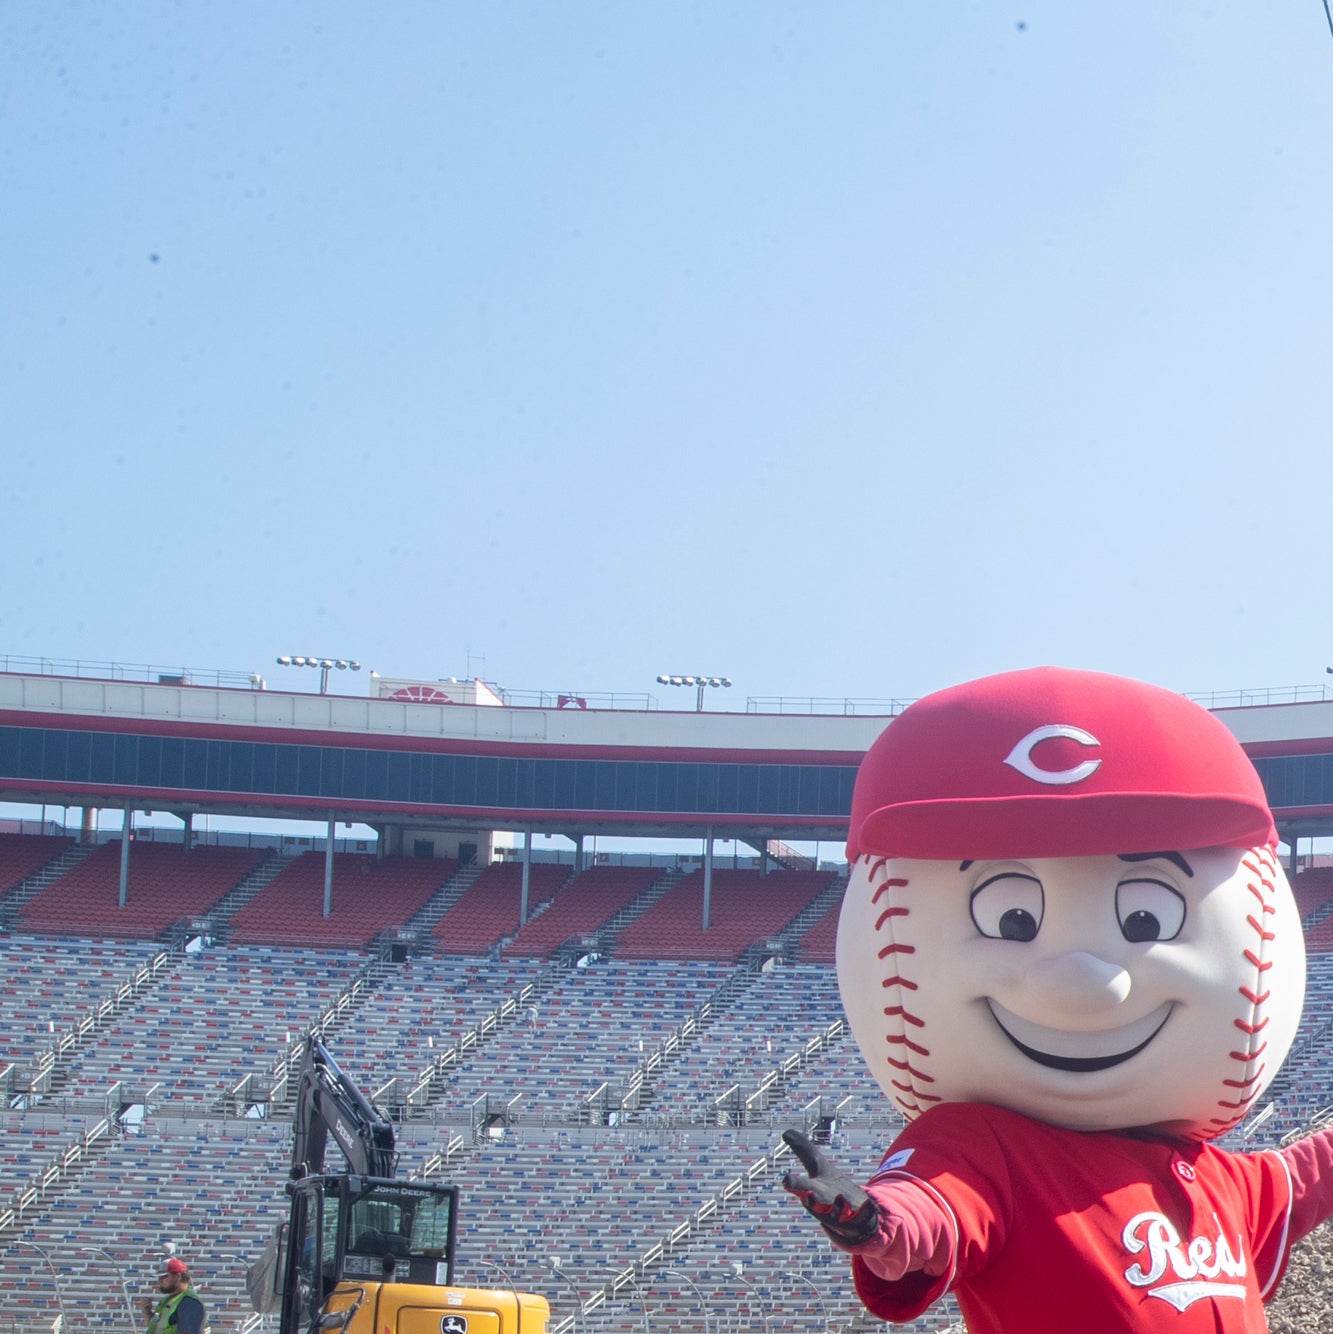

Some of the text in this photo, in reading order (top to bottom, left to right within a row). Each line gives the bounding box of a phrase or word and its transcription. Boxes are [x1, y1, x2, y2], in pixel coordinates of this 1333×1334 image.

[1003, 724, 1102, 785] C
[336, 1118, 354, 1149] DEERE
[374, 1185, 432, 1198] JOHN DEERE
